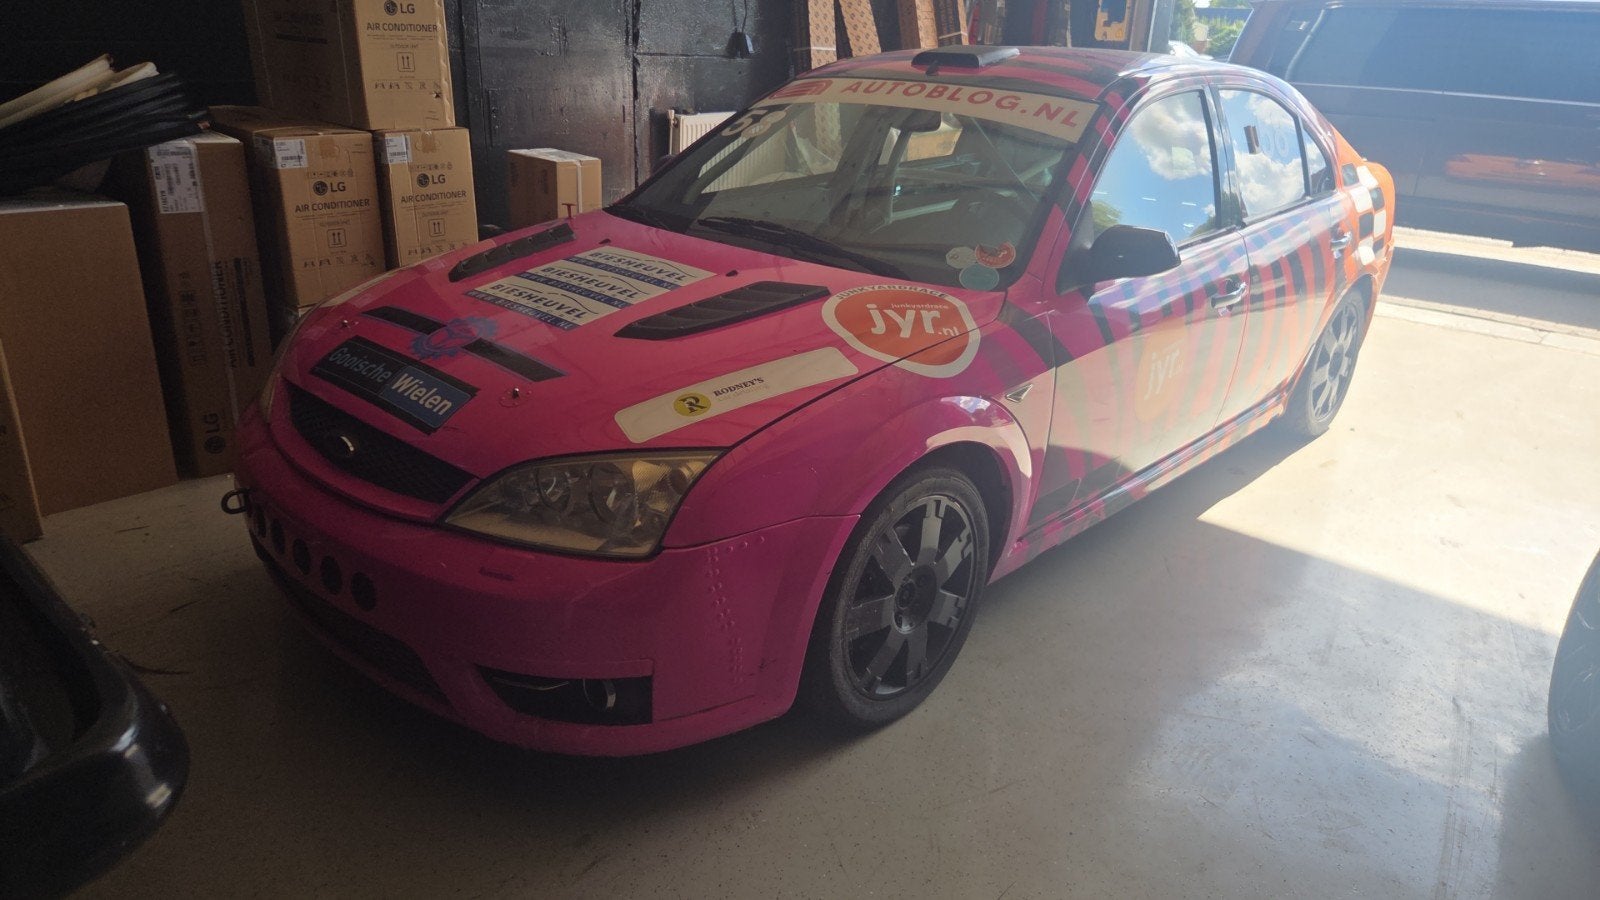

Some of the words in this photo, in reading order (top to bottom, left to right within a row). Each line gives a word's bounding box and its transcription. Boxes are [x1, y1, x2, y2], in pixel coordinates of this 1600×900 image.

[400, 3, 416, 14] LG
[366, 22, 381, 31] AIR
[382, 22, 438, 32] CONDITIONER
[842, 79, 1080, 129] AUTOBLOG.NL
[330, 182, 346, 192] LG
[431, 174, 446, 184] LG
[294, 203, 310, 213] AIR
[311, 198, 371, 211] CONDITIONER
[400, 194, 413, 203] AIR
[415, 190, 467, 202] CONDITIONER
[588, 251, 688, 281] BIESHEUVEL
[540, 266, 638, 299] BIESHEUVEL
[835, 284, 950, 300] JUNKYARDRACE
[489, 283, 589, 319] BIESHEUVEL
[328, 346, 392, 383] Gooische
[391, 371, 453, 416] Wielen
[712, 377, 765, 397] RODNEY'S
[204, 413, 220, 433] LG
